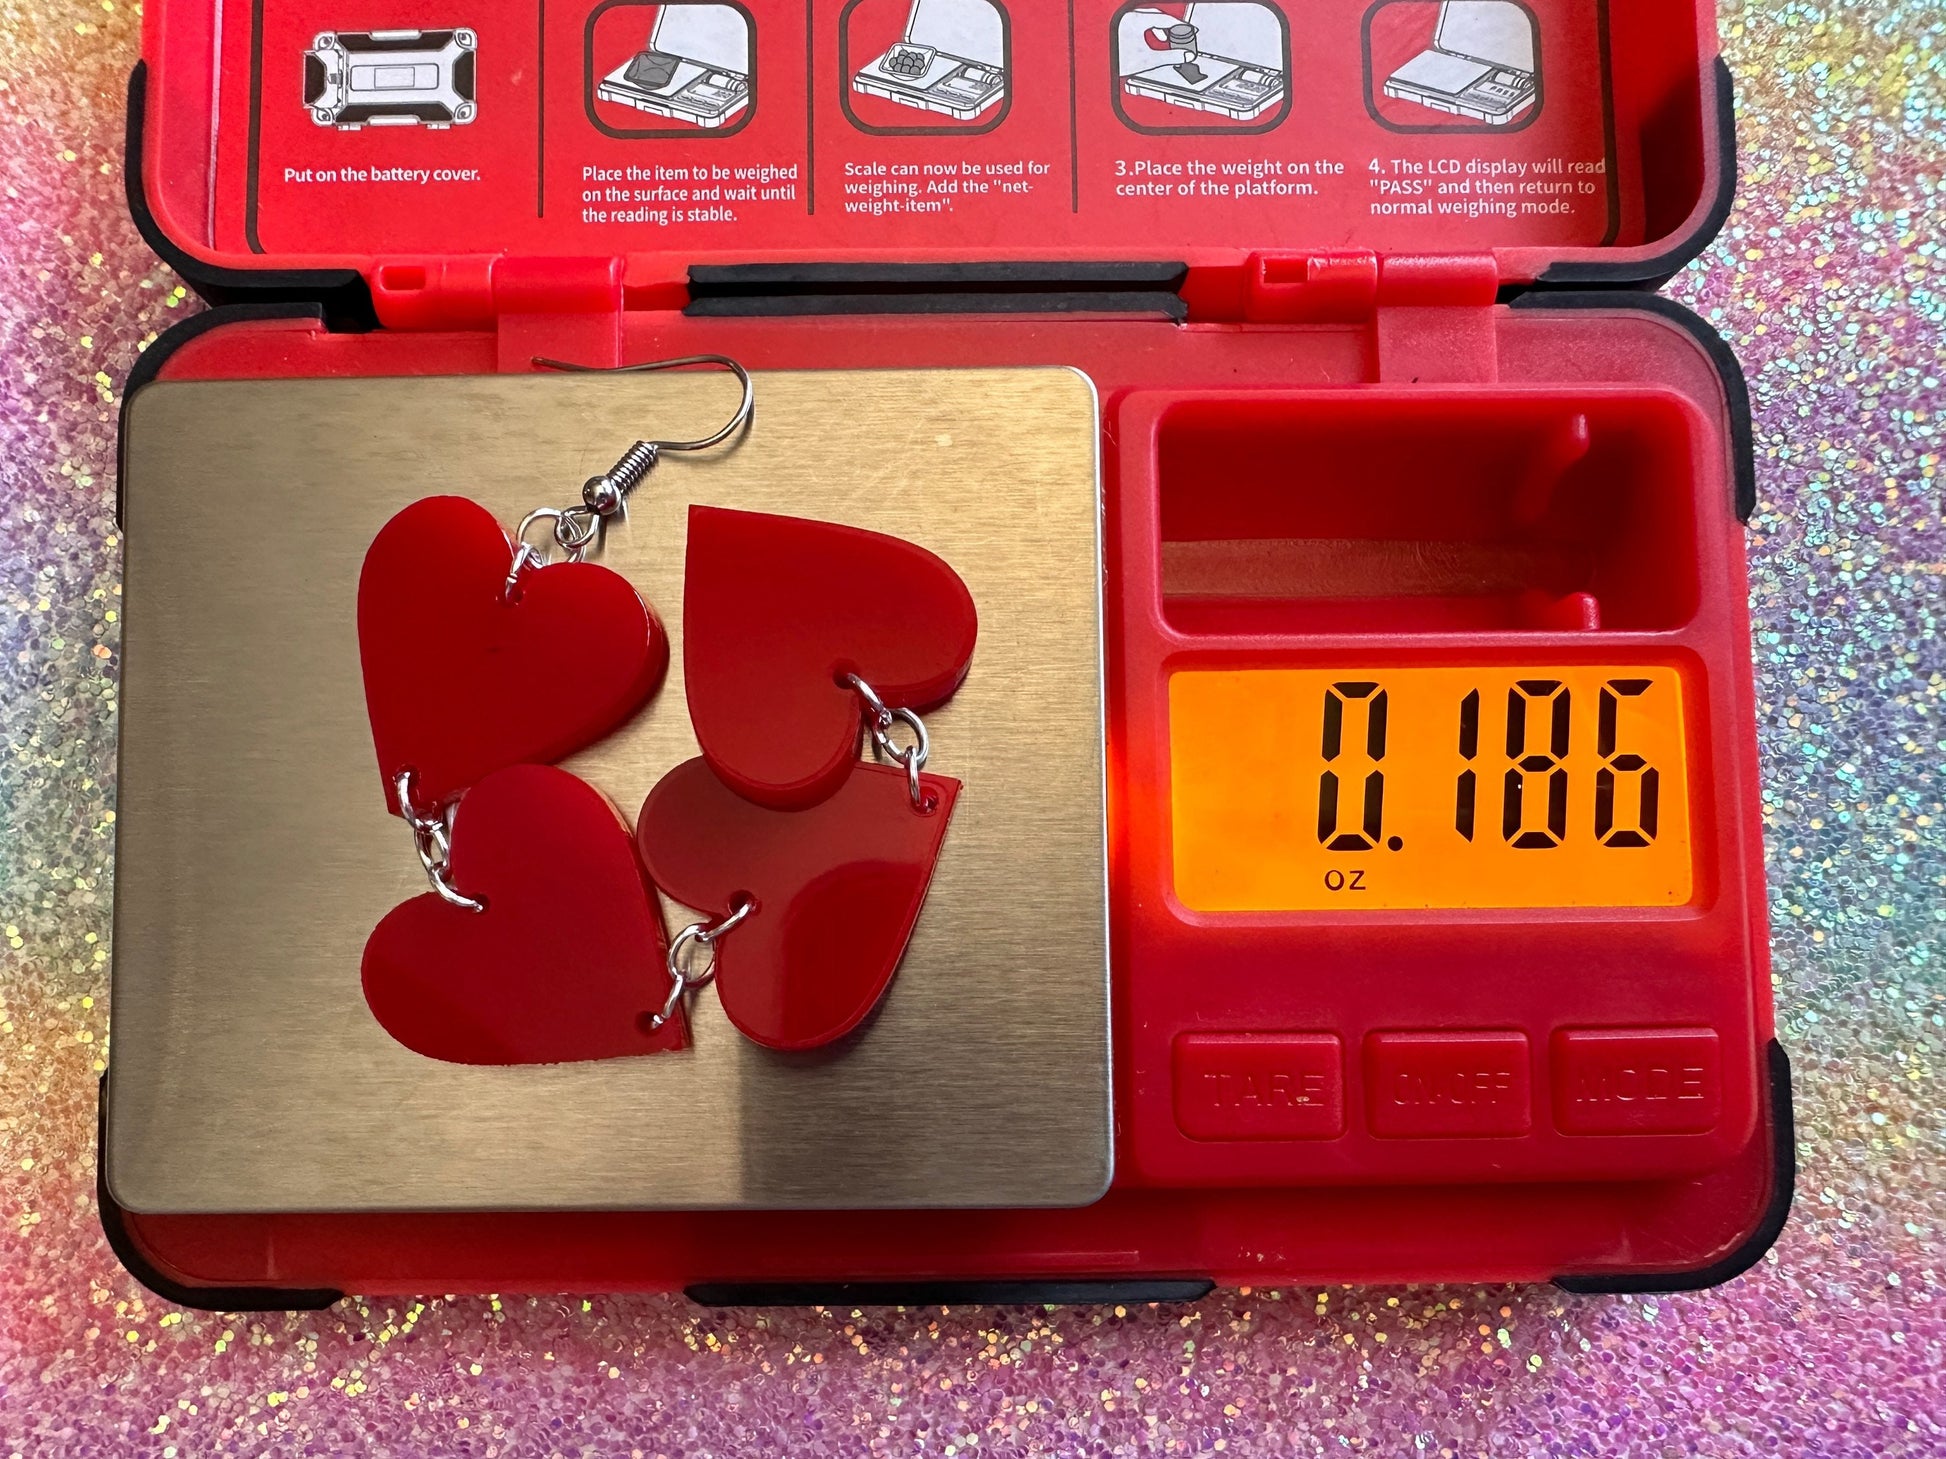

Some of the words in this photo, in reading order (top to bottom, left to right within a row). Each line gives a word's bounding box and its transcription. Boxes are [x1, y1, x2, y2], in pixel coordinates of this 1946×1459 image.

[285, 168, 312, 182] Put
[316, 171, 336, 182] on
[341, 167, 367, 181] the
[371, 166, 430, 184] battery
[433, 170, 480, 181] cover.
[583, 166, 622, 181] Place
[626, 165, 650, 180] the
[655, 165, 688, 180] item
[693, 166, 707, 180] to
[712, 165, 730, 179] be
[734, 164, 797, 183] weighed
[845, 162, 886, 175] Scale
[891, 165, 918, 175] can
[924, 165, 957, 175] now
[962, 161, 981, 174] be
[986, 161, 1022, 174] used
[1028, 161, 1050, 174] for
[1115, 160, 1182, 176] 3.Place
[1187, 160, 1216, 175] the
[1222, 159, 1282, 178] weight
[1288, 163, 1309, 174] on
[1315, 160, 1344, 174] the
[1369, 158, 1385, 174] 4.
[1391, 159, 1423, 174] The
[1429, 159, 1460, 174] LCD
[1466, 159, 1527, 177] display
[1532, 159, 1562, 173] will
[1568, 158, 1605, 173] read
[583, 191, 601, 202] on
[606, 186, 630, 201] the
[634, 186, 687, 201] surface
[692, 185, 719, 200] and
[724, 185, 756, 200] wait
[761, 184, 795, 200] until
[845, 180, 921, 197] weighing.
[927, 180, 957, 193] Add
[963, 180, 988, 193] the
[994, 180, 1033, 192] "net-
[1116, 182, 1173, 195] center
[1178, 180, 1195, 195] of
[1200, 180, 1229, 195] the
[1235, 179, 1318, 198] platform.
[1370, 179, 1431, 194] "PASS"
[1438, 178, 1470, 194] and
[1475, 179, 1514, 194] then
[1520, 181, 1572, 194] return
[1578, 181, 1595, 194] to
[582, 207, 607, 222] the
[611, 207, 668, 226] reading
[672, 206, 683, 222] is
[688, 206, 737, 221] stable.
[845, 198, 952, 215] weight-item".
[1371, 199, 1432, 214] normal
[1438, 198, 1517, 218] weighing
[1522, 199, 1574, 213] mode.
[1317, 678, 1660, 852] 0.186
[1203, 1073, 1326, 1107] TARE
[1576, 1067, 1705, 1102] MODE
